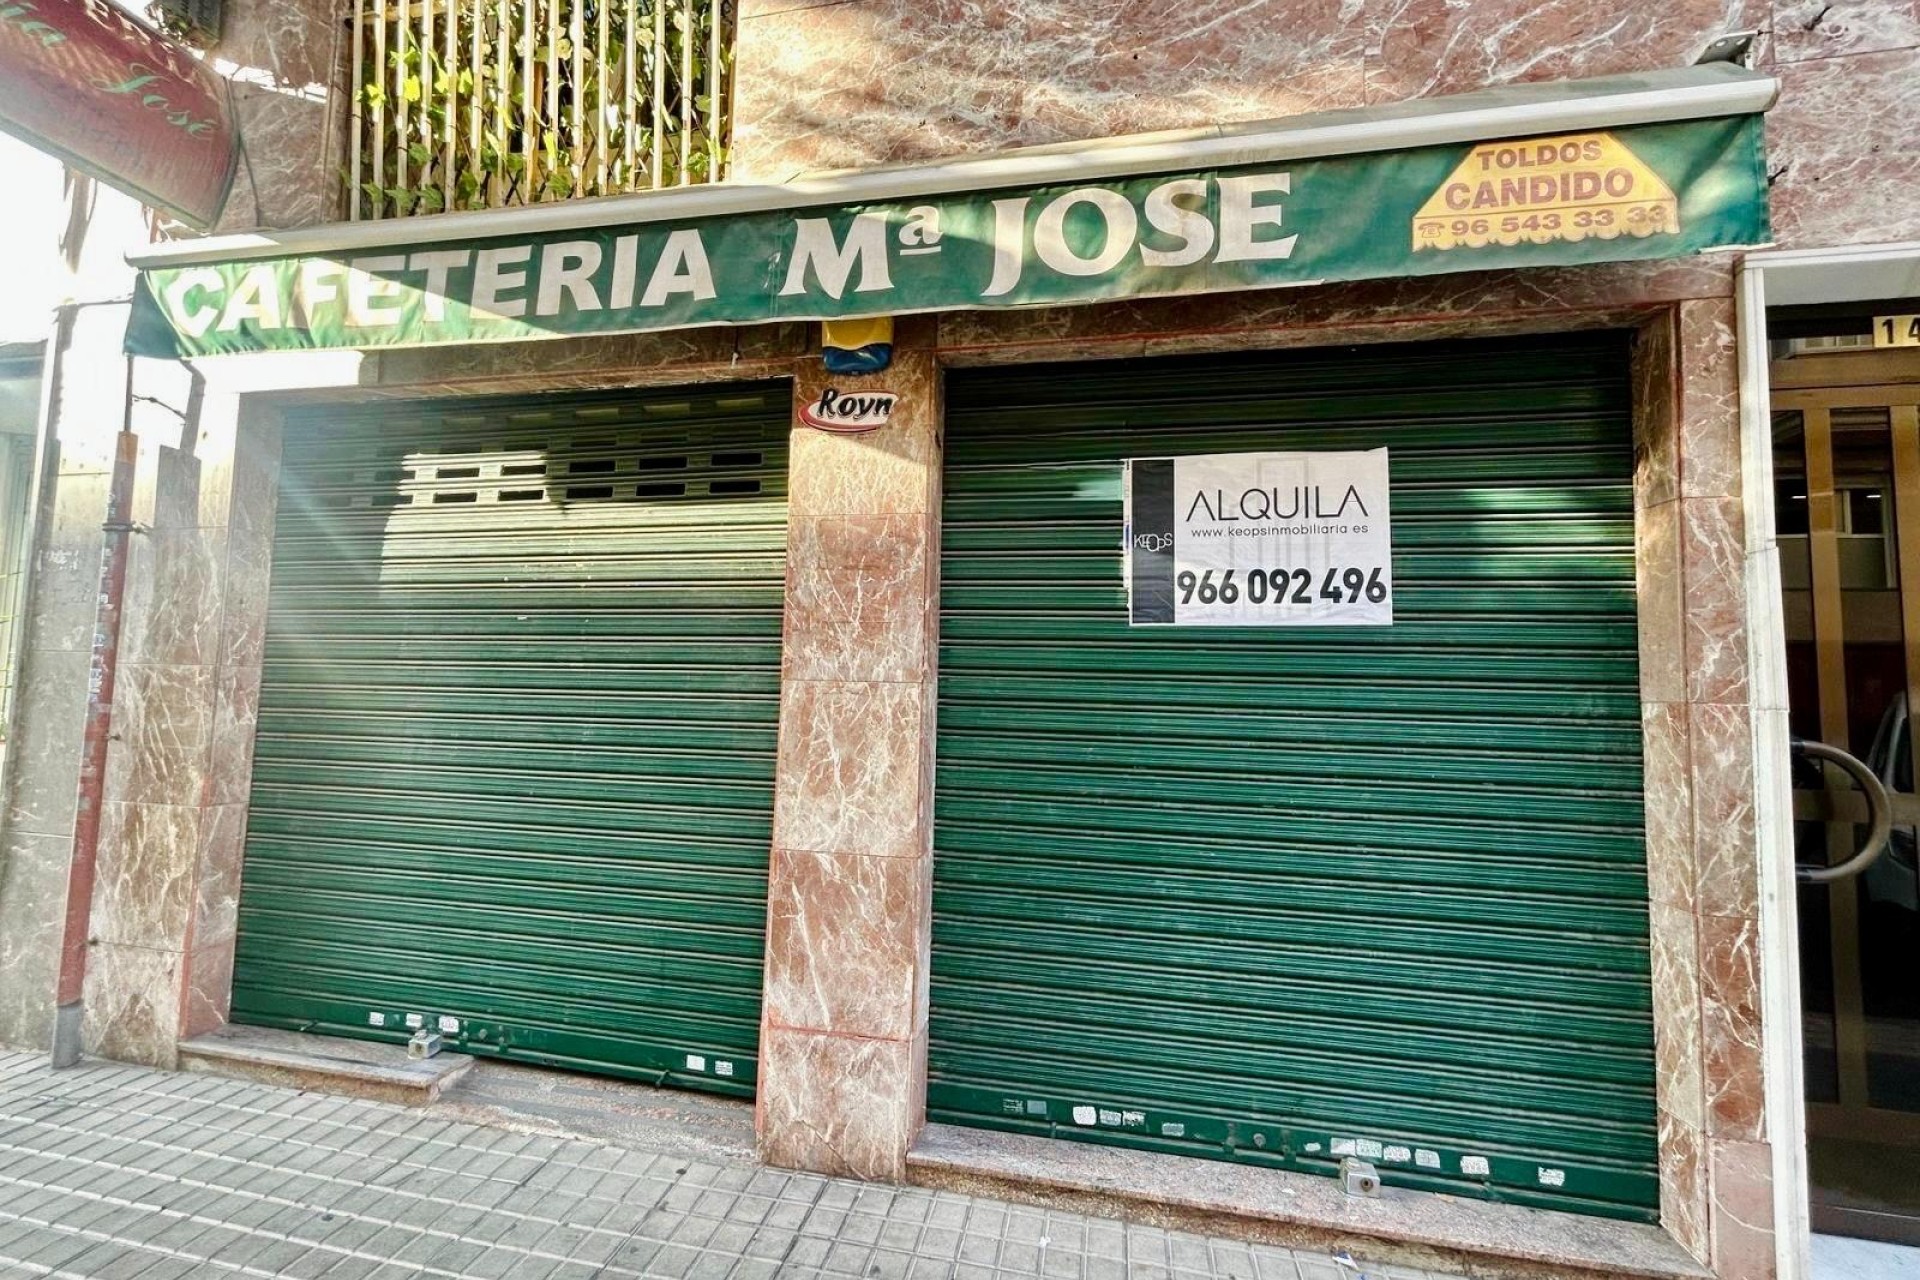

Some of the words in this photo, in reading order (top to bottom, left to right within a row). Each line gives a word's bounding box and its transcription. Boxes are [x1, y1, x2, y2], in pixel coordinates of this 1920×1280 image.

[1477, 139, 1602, 171] TOLDOS
[1445, 167, 1634, 211] CANDIDO
[1451, 219, 1489, 237] 96
[1501, 213, 1562, 233] 543
[1573, 208, 1615, 228] 33
[1627, 205, 1667, 225] 33
[164, 228, 717, 338] CAFETERIA
[980, 172, 1299, 297] JOSE
[1186, 484, 1369, 522] ALQUILA
[1191, 523, 1369, 539] www.keopsinmobiliaria.es
[1177, 569, 1239, 605] 966
[1247, 568, 1312, 604] 092
[1319, 567, 1387, 605] 496
